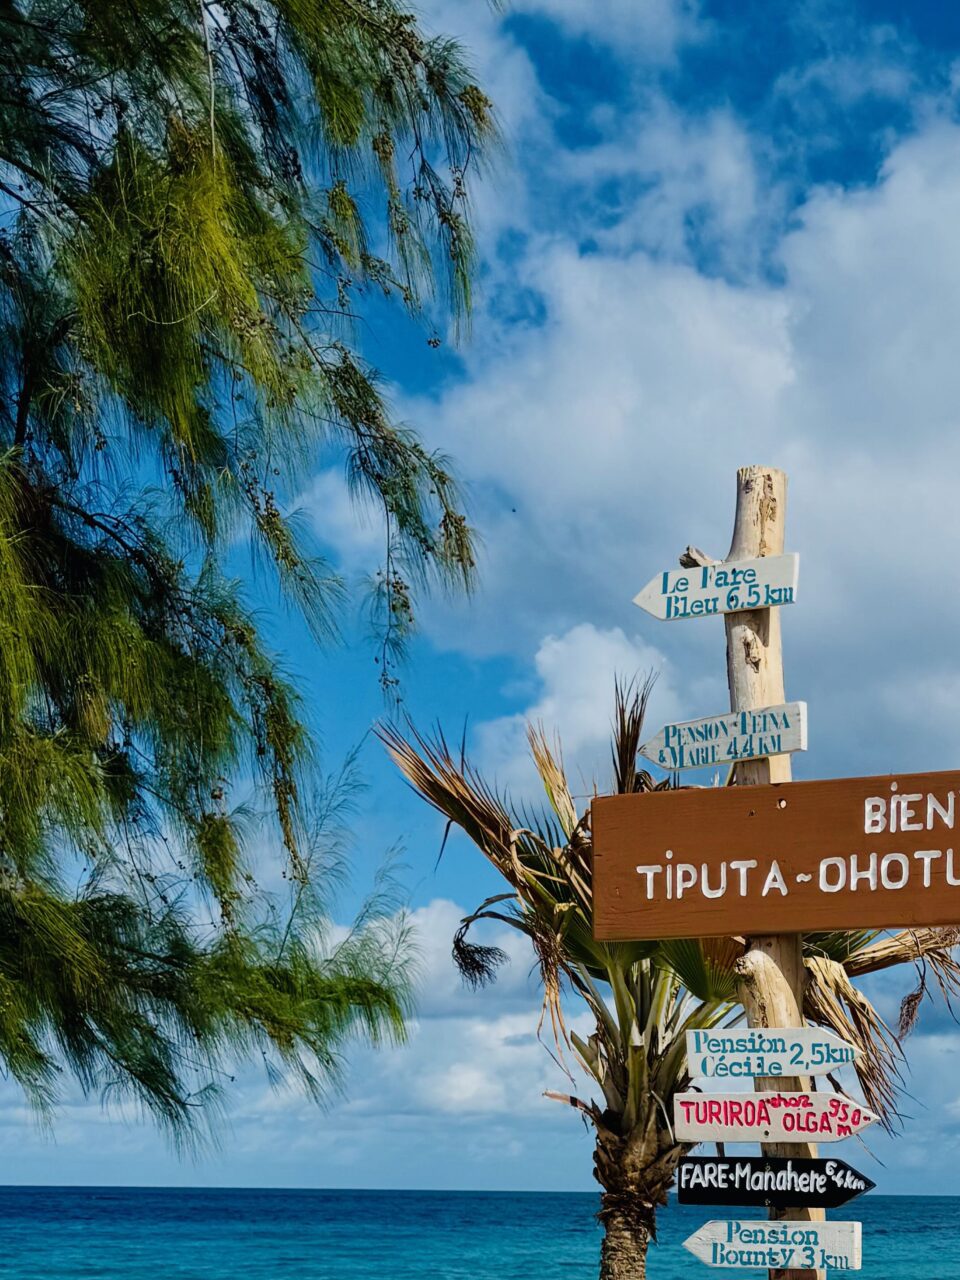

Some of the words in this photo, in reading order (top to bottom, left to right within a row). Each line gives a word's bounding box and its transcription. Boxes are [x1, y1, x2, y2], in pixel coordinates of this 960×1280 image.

[661, 572, 689, 594] Le
[700, 566, 757, 589] Fare
[665, 596, 719, 619] Bleu
[664, 720, 728, 748] PENSION
[735, 711, 791, 735] TEINA
[658, 749, 666, 763] &
[668, 744, 721, 768] MARIE
[694, 1031, 787, 1053] Pension
[701, 1055, 782, 1077] Cécile
[680, 1099, 771, 1127] TURIROA
[783, 1112, 832, 1133] OLGA
[727, 1222, 819, 1246] Pension
[712, 1242, 794, 1268] Bounty
[801, 1247, 815, 1268] 3
